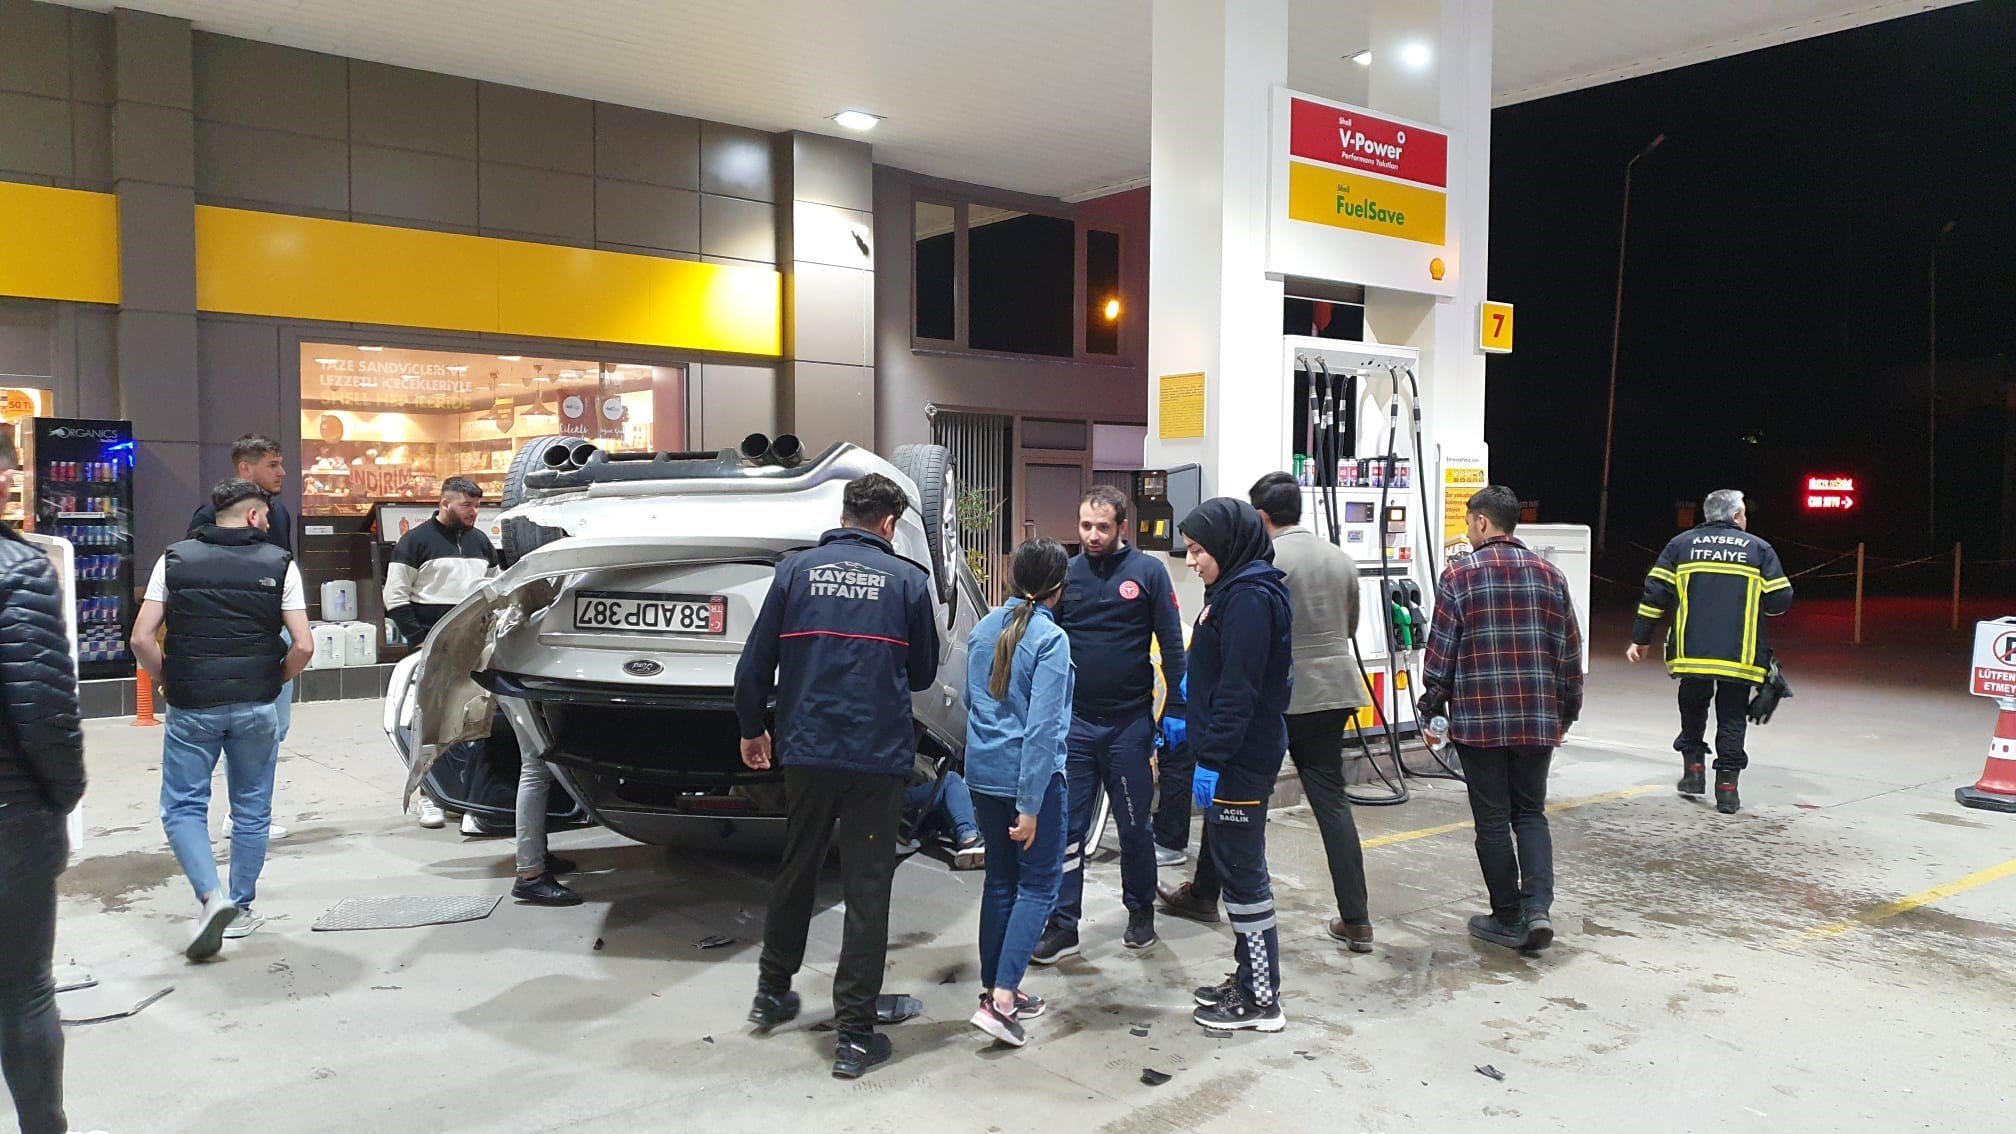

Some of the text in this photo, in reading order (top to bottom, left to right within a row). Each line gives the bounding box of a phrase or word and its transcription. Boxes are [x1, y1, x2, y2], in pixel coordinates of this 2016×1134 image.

[1339, 117, 1352, 126] Shell
[1339, 128, 1402, 159] V-Power
[1341, 151, 1375, 165] Performans
[1337, 184, 1350, 193] Shell
[1336, 195, 1405, 225] FuelSave
[1493, 314, 1504, 338] 7
[59, 427, 118, 439] ORGANICS
[810, 582, 880, 600] İTFAİYE
[579, 600, 710, 629] 58 ADP 387
[1979, 669, 2016, 682] LÜTFEN
